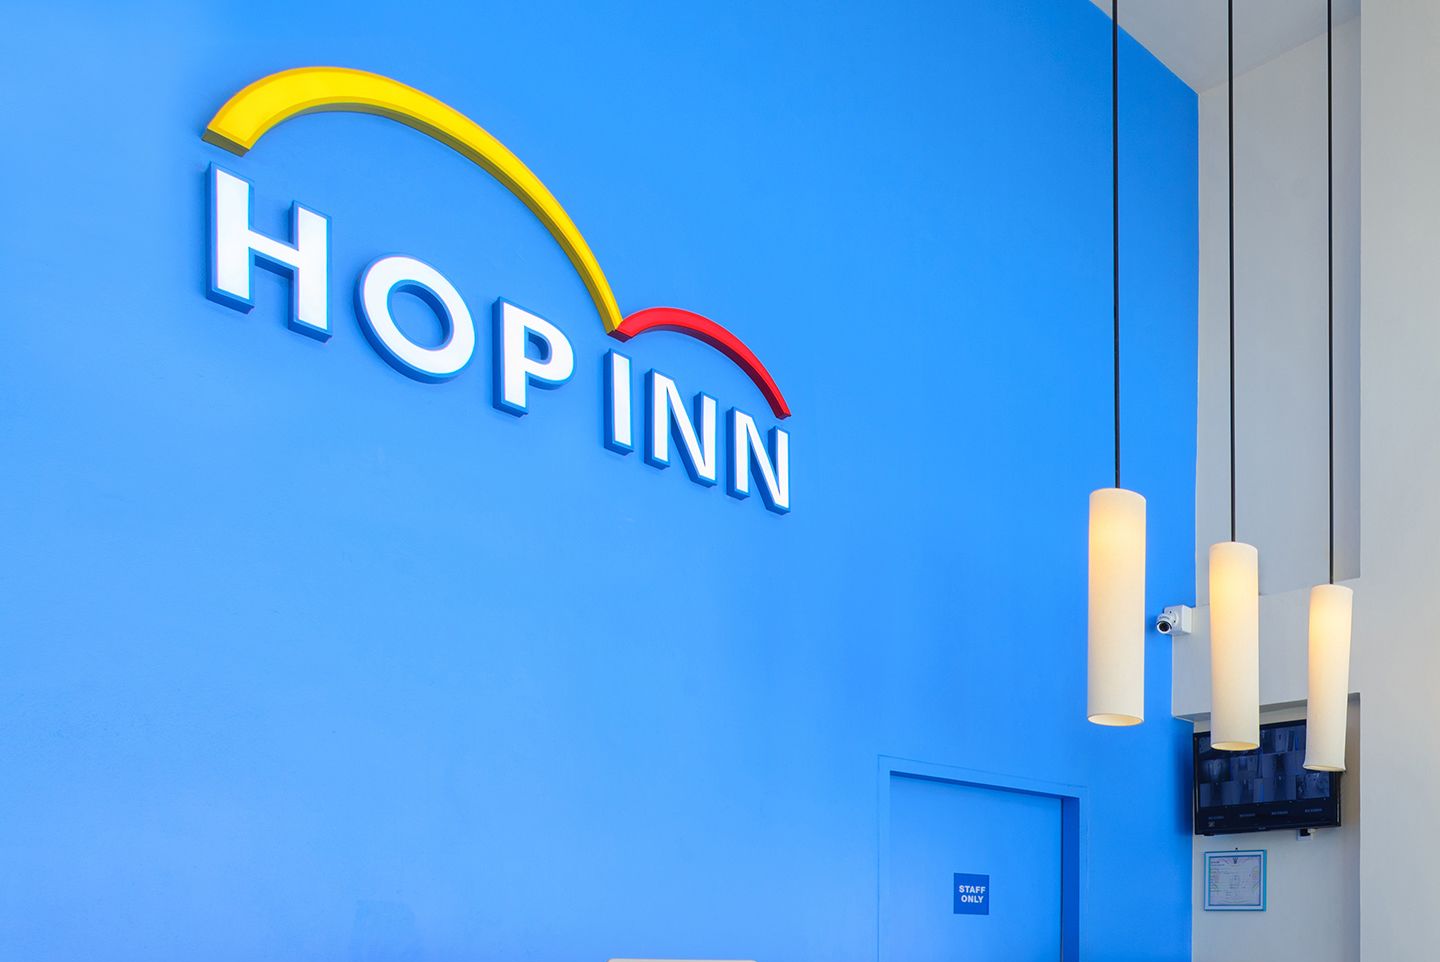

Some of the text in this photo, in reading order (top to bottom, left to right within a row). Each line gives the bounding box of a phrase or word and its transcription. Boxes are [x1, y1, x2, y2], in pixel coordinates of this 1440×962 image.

[205, 161, 790, 515] HOP INN
[959, 885, 986, 894] STAFF
[961, 895, 984, 903] ONLY
